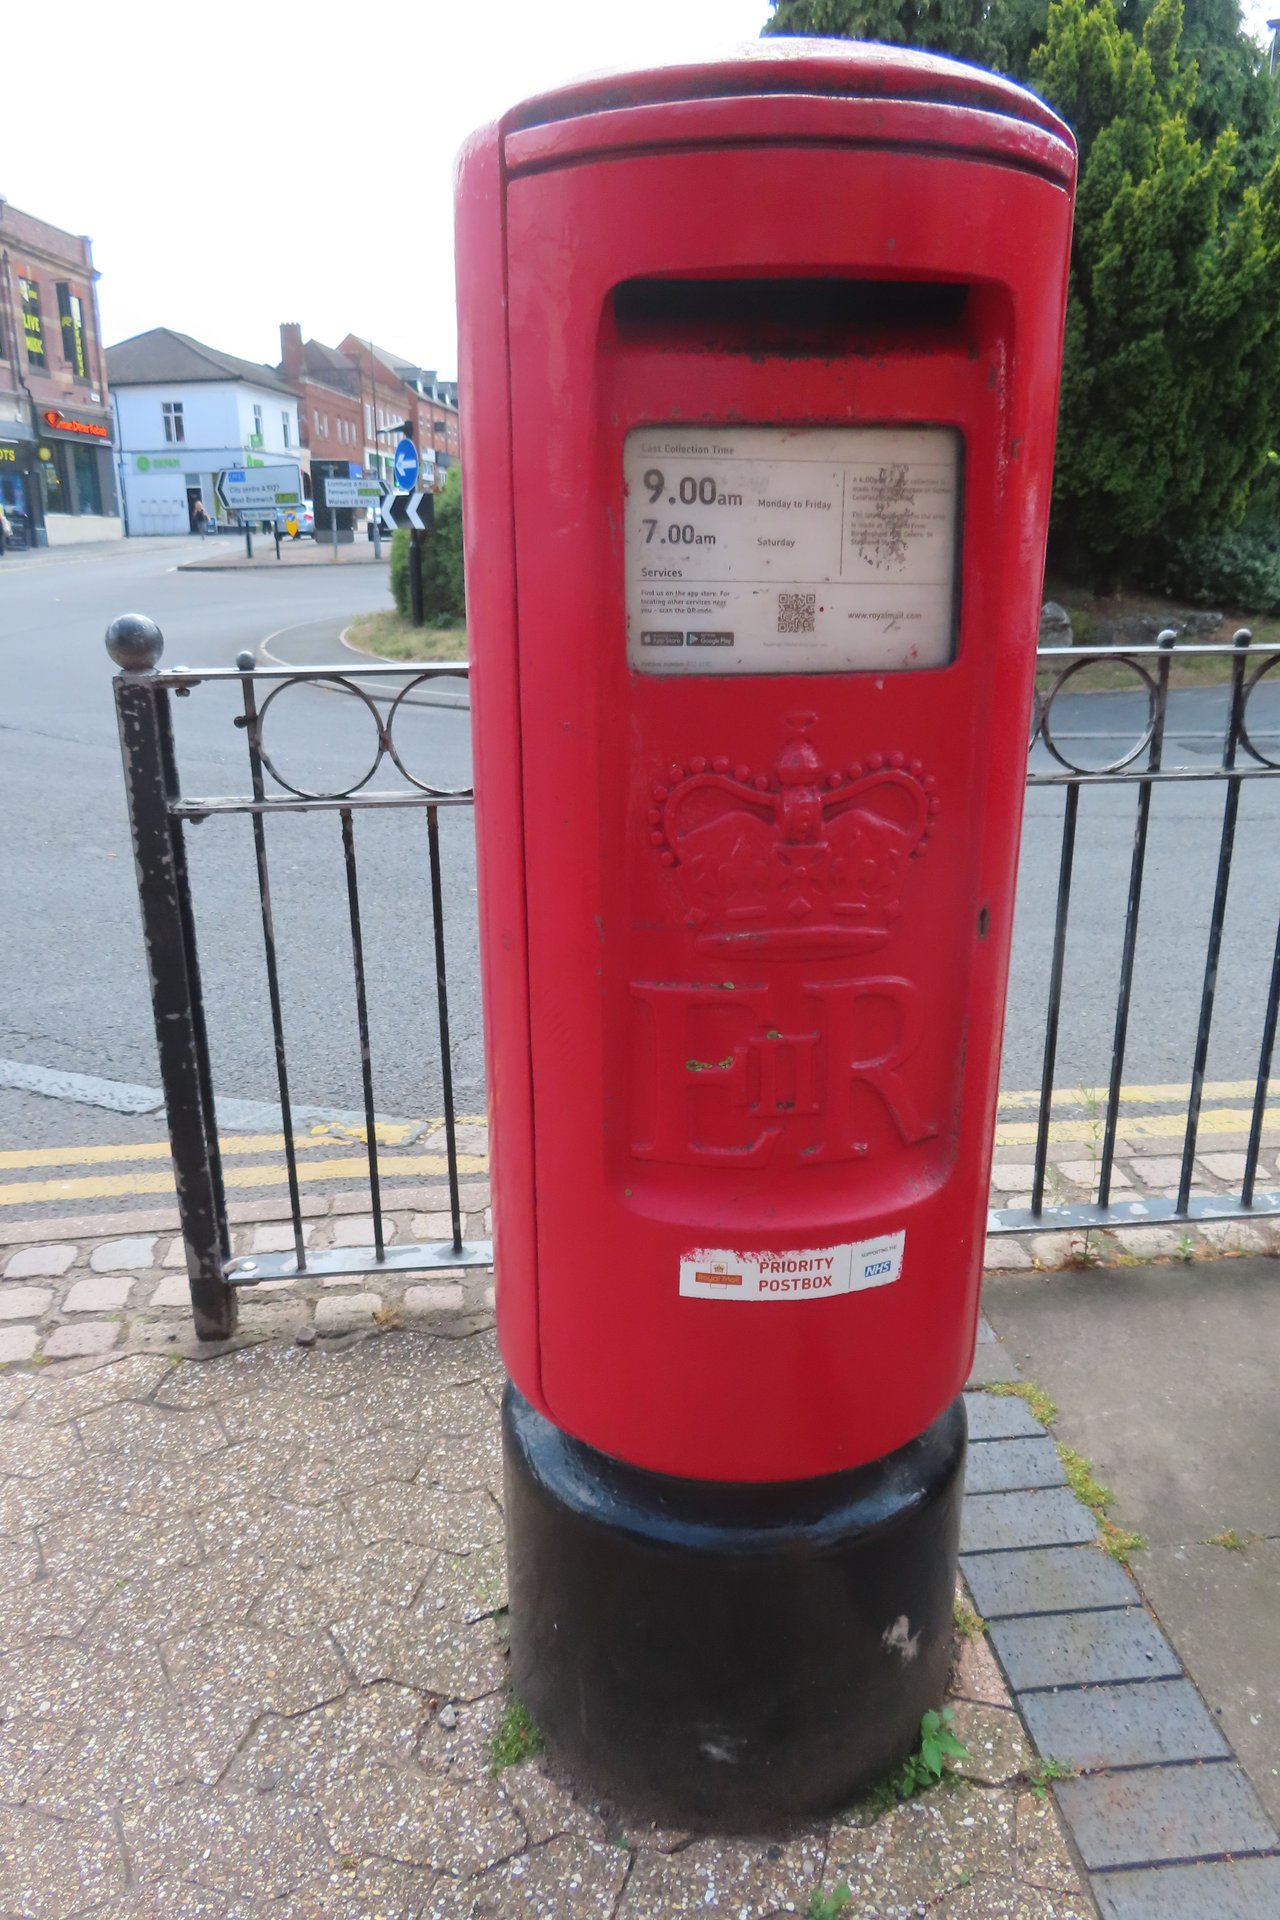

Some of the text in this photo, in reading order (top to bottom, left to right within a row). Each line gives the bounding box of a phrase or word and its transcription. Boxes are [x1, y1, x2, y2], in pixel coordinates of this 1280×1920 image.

[641, 443, 735, 455] Last Collection Time
[757, 499, 832, 511] Monday to Friday
[757, 537, 796, 549] Saturday
[641, 567, 683, 578] Services
[641, 589, 655, 597] Find
[847, 611, 922, 621] www.royalmail.com
[666, 636, 681, 644] Store
[701, 636, 732, 645] Google Play
[861, 1247, 888, 1258] SUPPORTING
[759, 1256, 835, 1274] PRIORITY
[865, 1261, 890, 1277] NHS
[697, 1273, 722, 1283] Royal
[758, 1275, 833, 1292] POSTBOX
